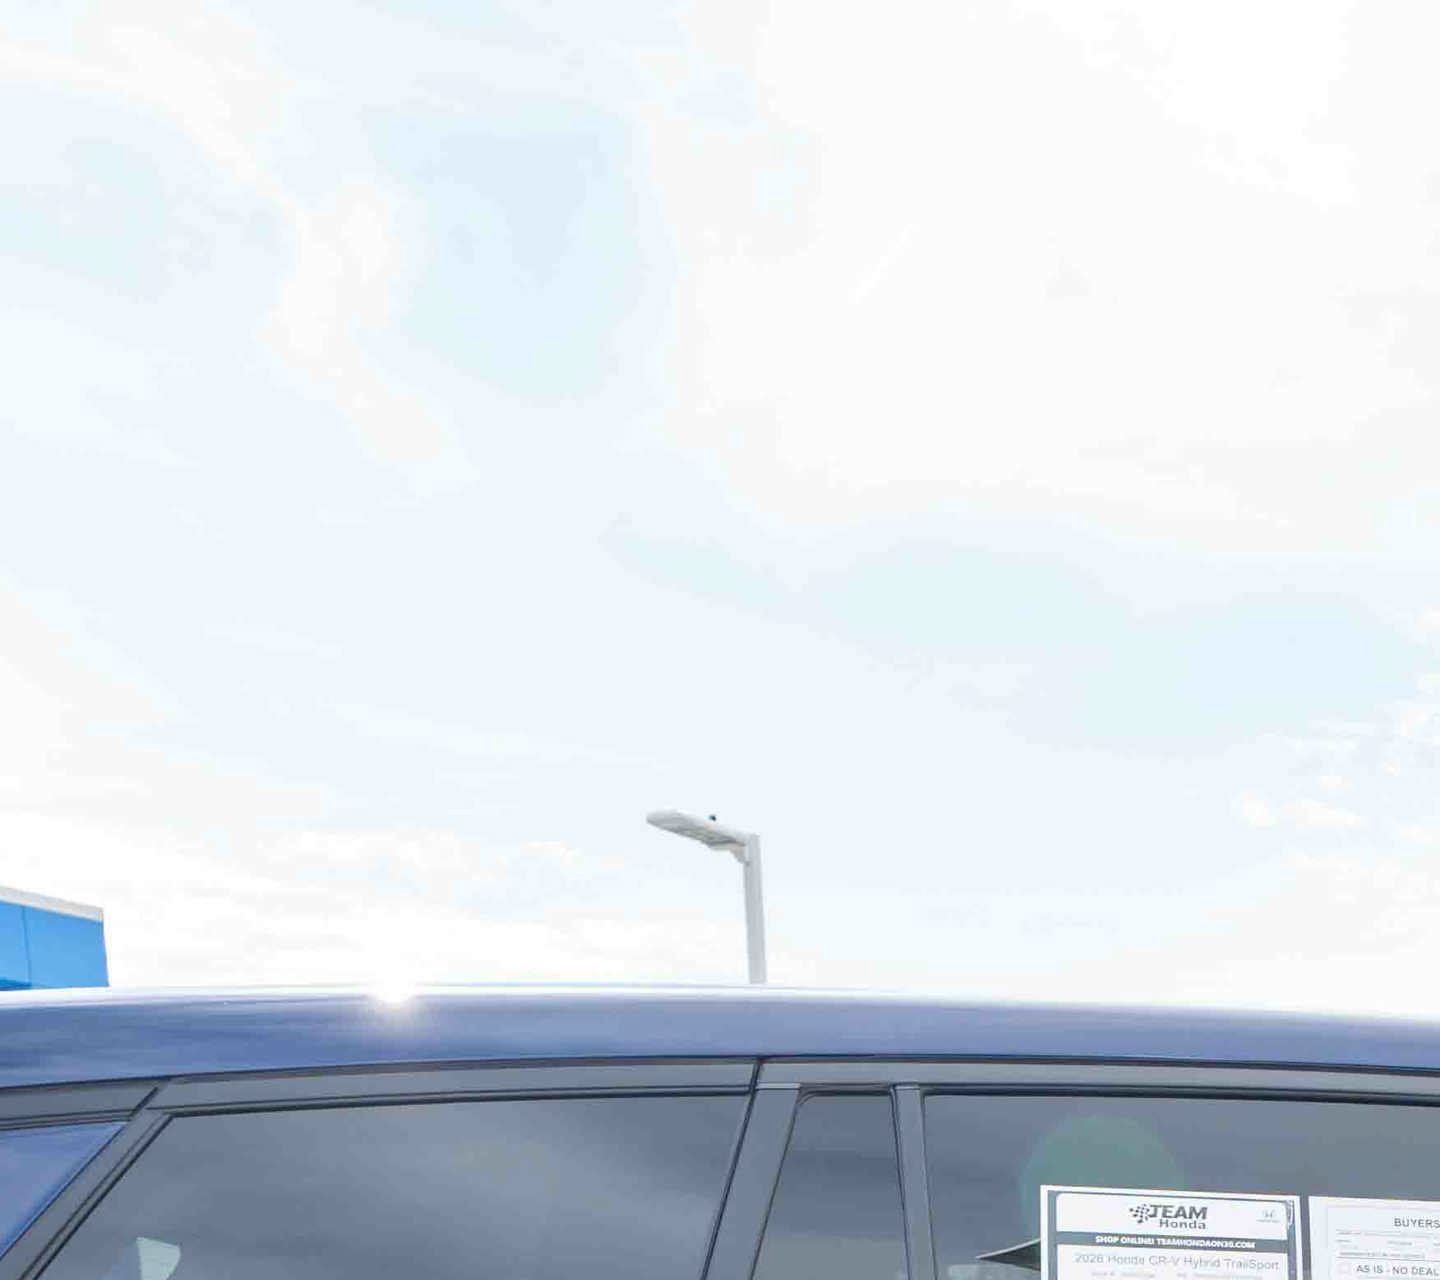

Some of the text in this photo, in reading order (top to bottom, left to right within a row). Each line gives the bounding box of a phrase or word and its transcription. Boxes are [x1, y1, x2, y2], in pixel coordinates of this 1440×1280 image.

[1148, 1204, 1208, 1220] TEAM
[1159, 1219, 1207, 1231] Honda
[1394, 1217, 1440, 1230] BUYERS
[1095, 1235, 1119, 1245] SHOP
[1148, 1255, 1181, 1267] CR-V
[1183, 1257, 1221, 1271] Hybrid
[1356, 1264, 1371, 1275] AS
[1373, 1265, 1384, 1275] IS
[1392, 1266, 1408, 1276] NO
